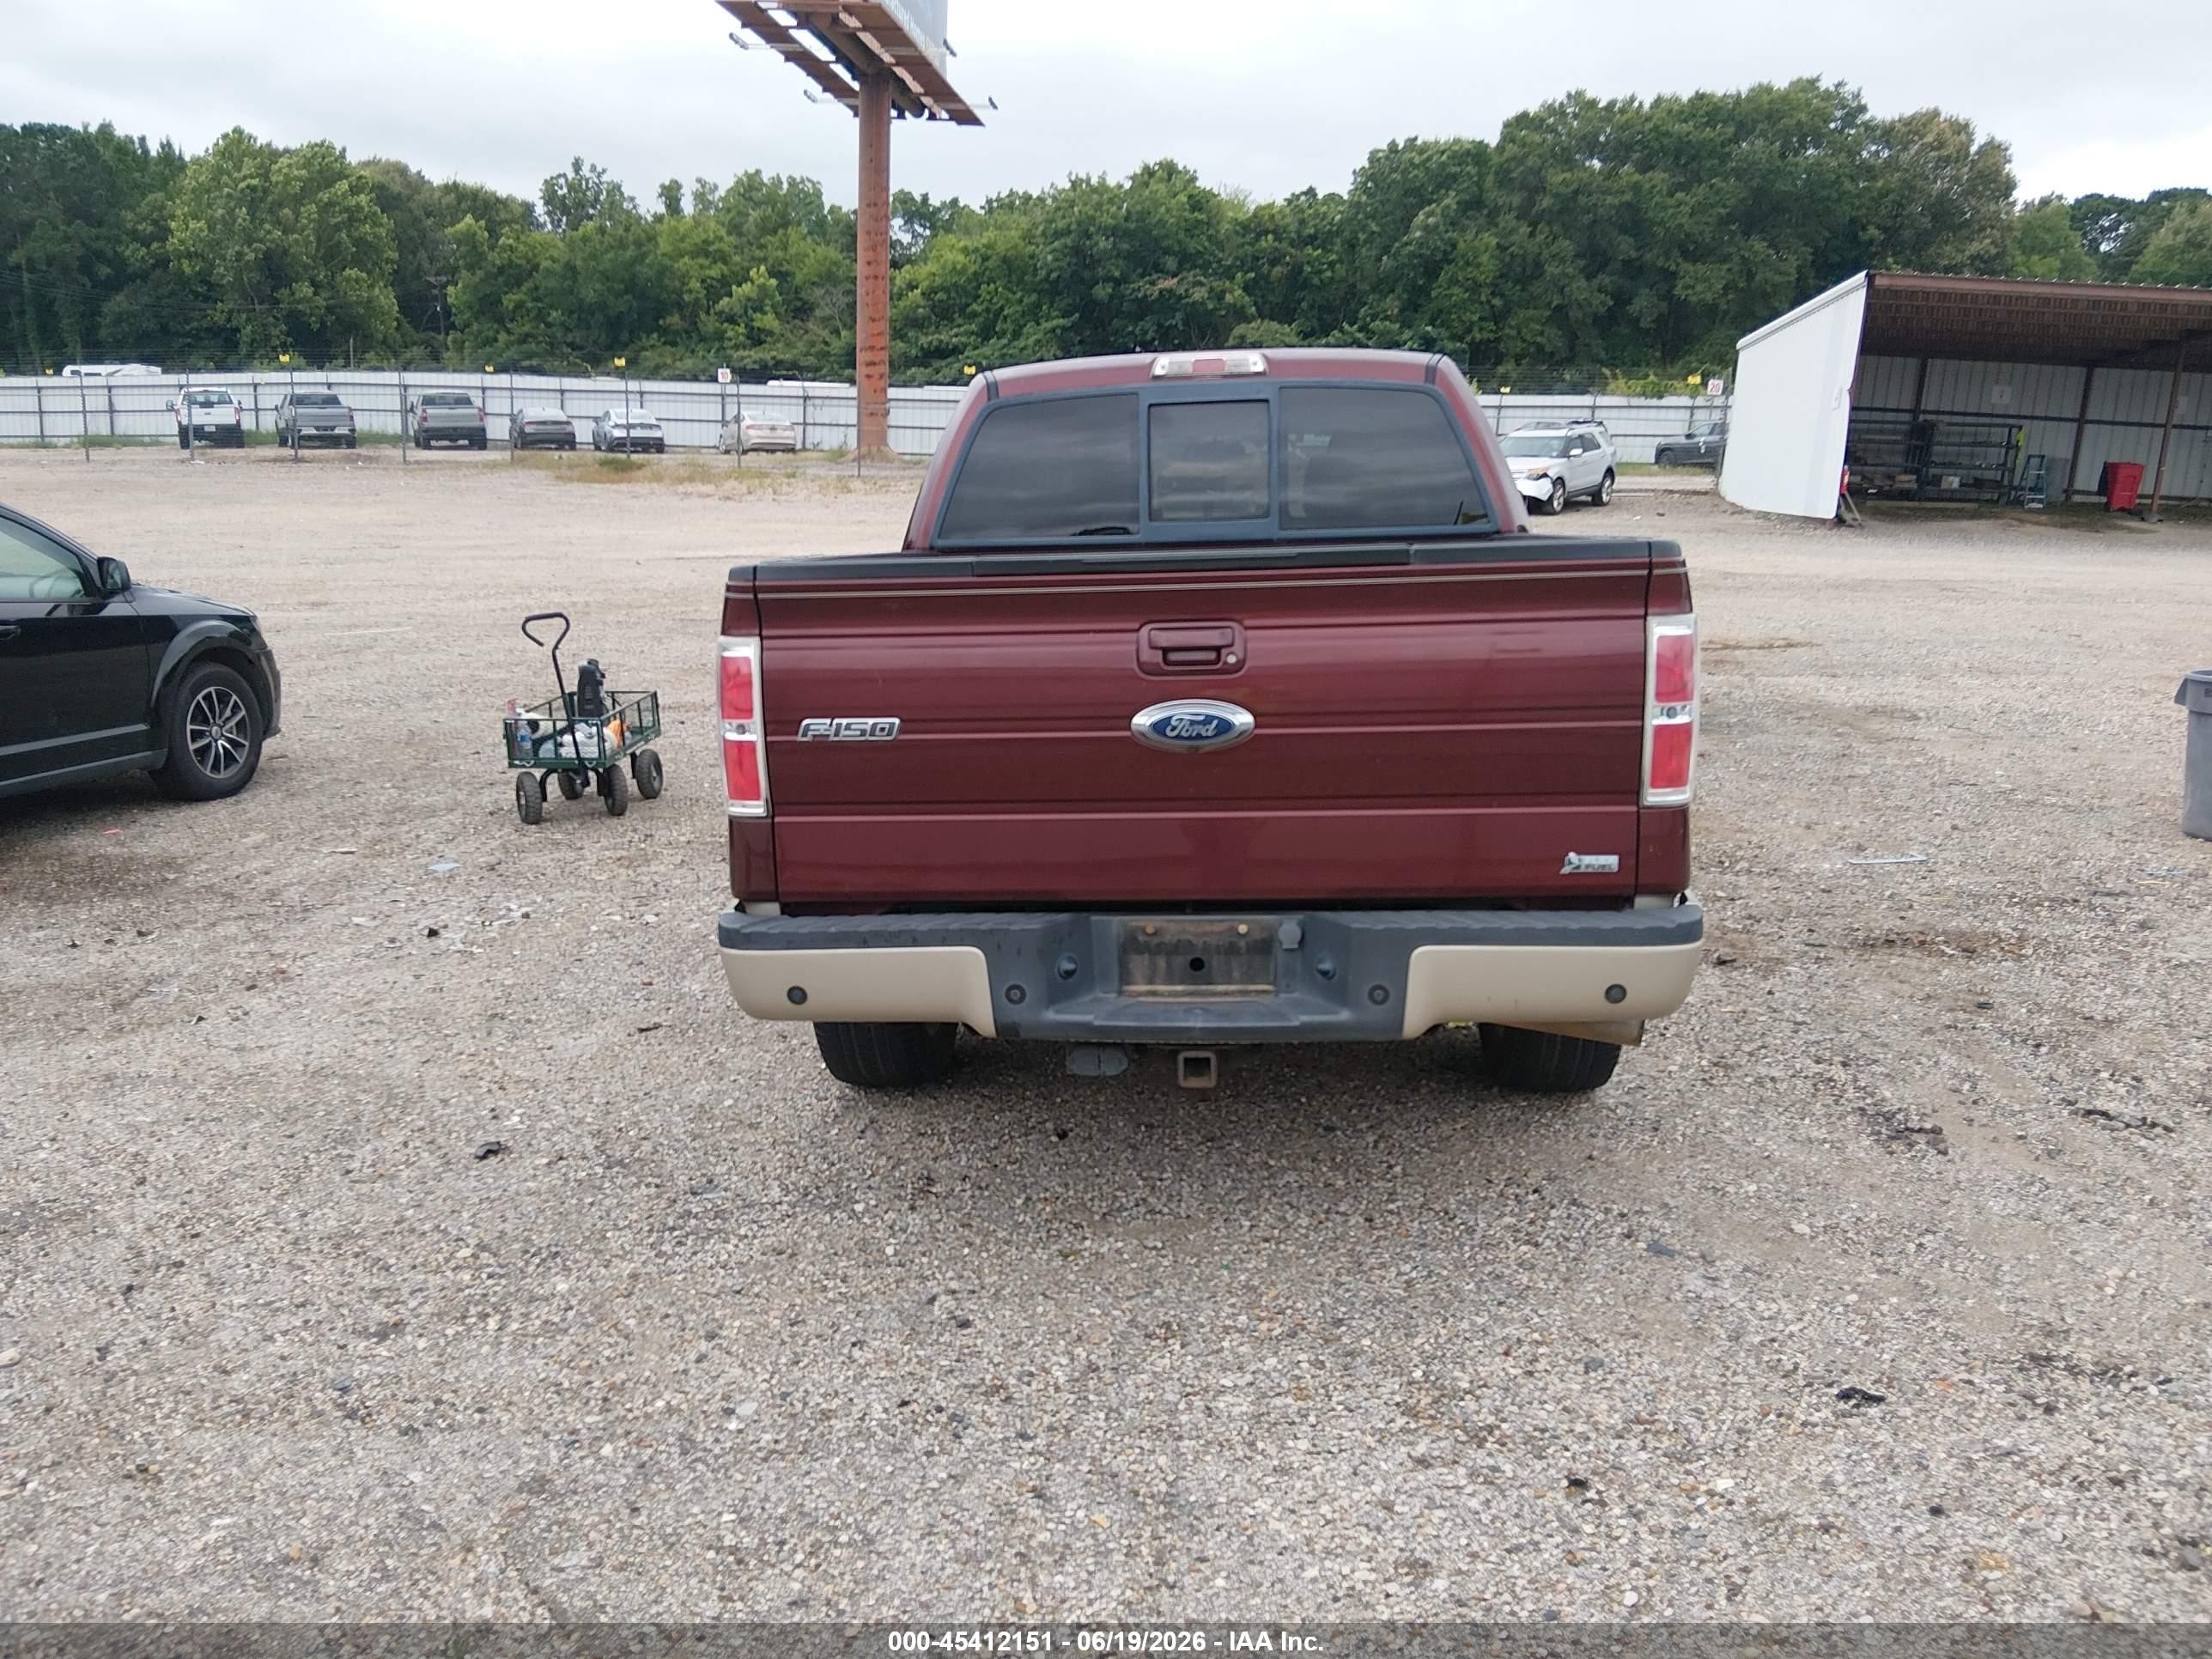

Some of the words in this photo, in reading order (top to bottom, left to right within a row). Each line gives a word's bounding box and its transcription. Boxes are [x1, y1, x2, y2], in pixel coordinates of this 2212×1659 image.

[1710, 382, 1722, 393] 20
[797, 717, 900, 742] F-150
[1165, 714, 1219, 738] Ford
